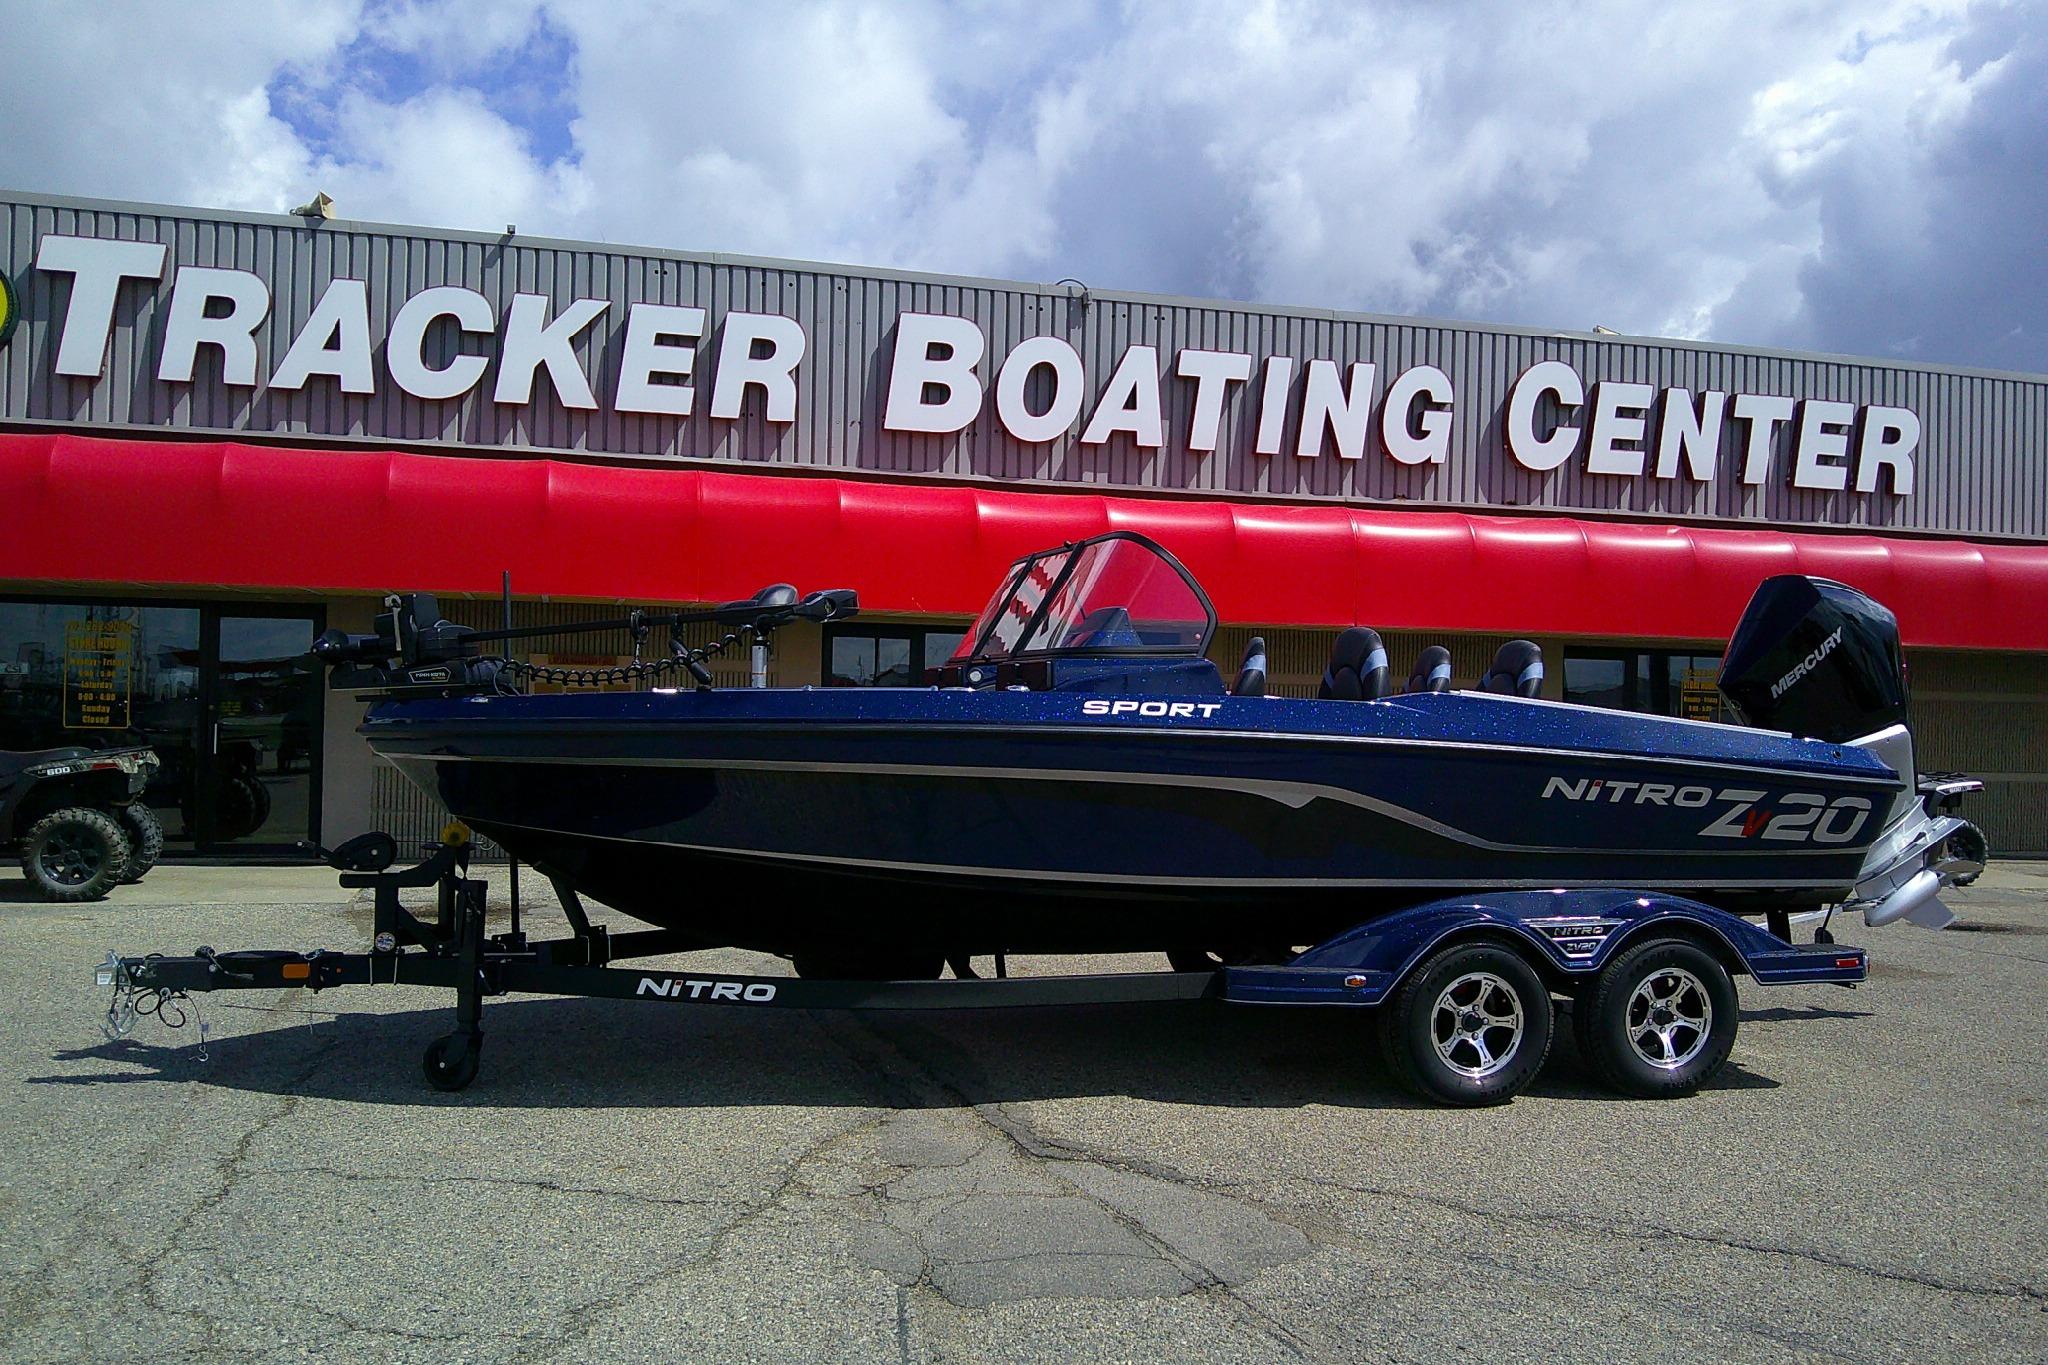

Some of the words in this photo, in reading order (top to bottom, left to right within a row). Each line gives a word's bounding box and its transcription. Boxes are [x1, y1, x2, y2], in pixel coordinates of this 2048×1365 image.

[35, 232, 806, 422] TRACKER
[882, 311, 1454, 465] BOATING
[1508, 361, 1920, 495] CENTER
[1770, 626, 1842, 699] MERCURY
[1082, 700, 1222, 719] SPORT
